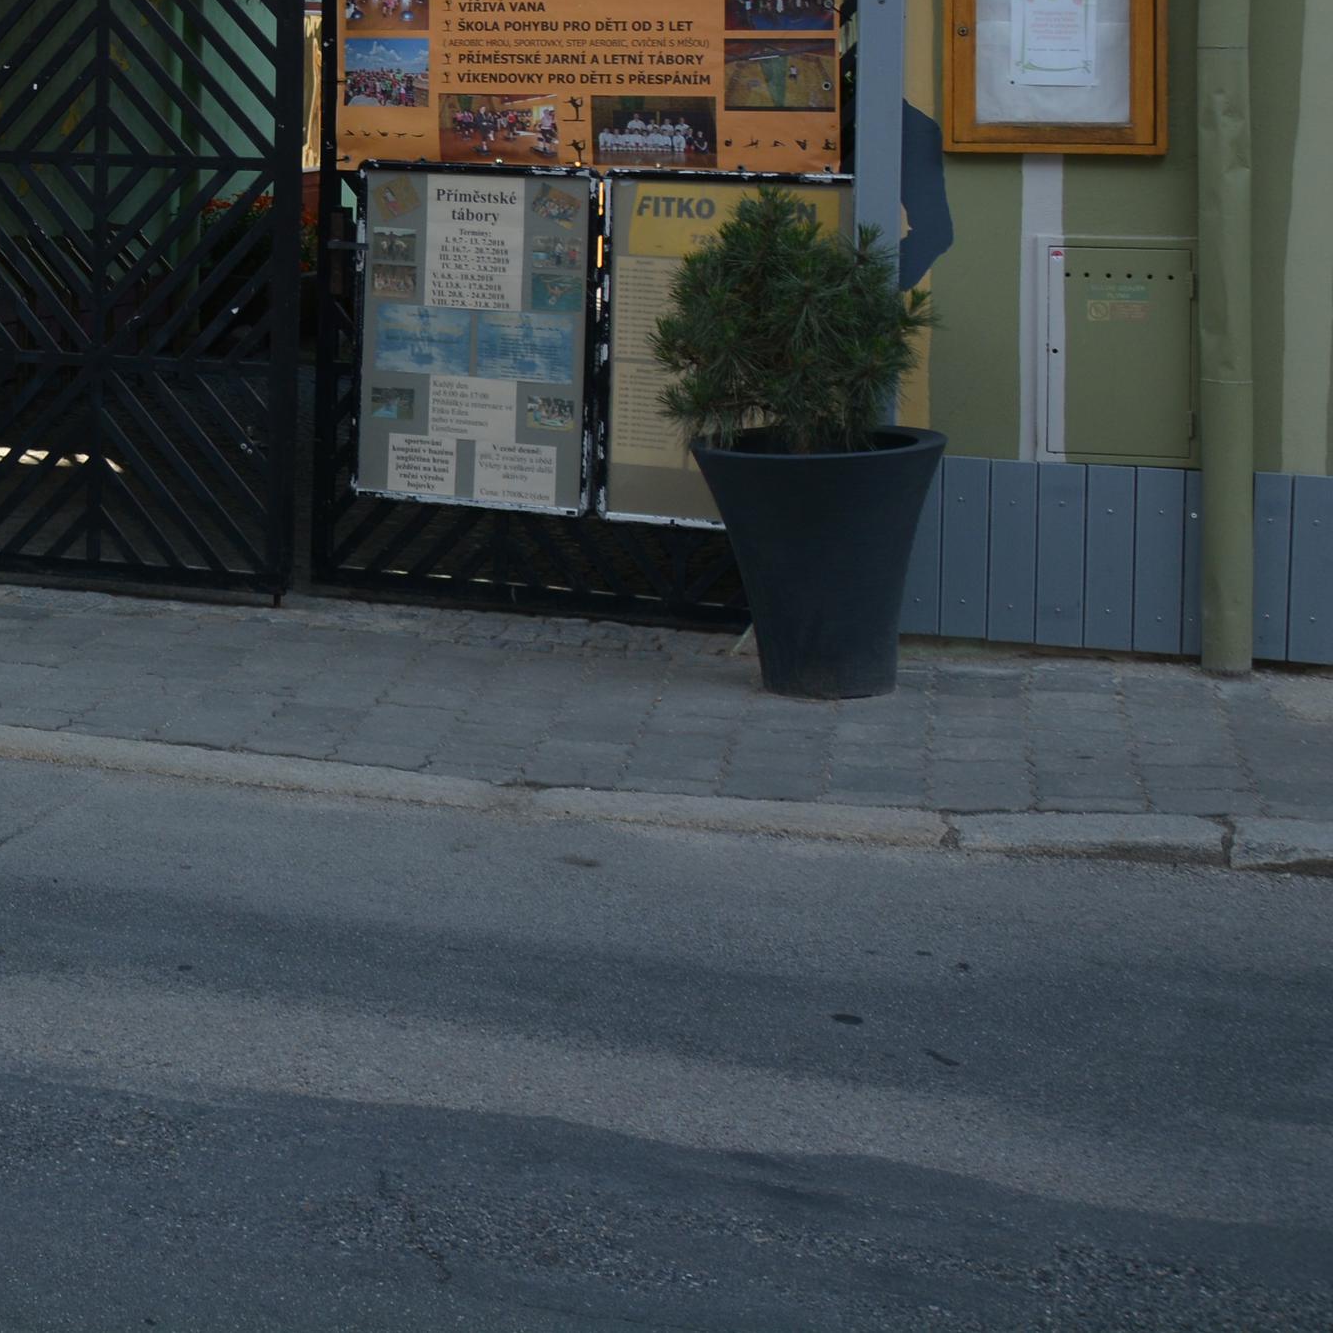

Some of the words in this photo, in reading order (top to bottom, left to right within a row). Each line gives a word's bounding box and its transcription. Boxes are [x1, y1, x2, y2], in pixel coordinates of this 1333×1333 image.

[509, 1, 545, 12] VANA
[458, 18, 500, 32] ŠKOLA
[504, 20, 559, 32] POHYBU
[563, 21, 591, 32] PRO
[595, 17, 628, 32] DĚTI
[631, 20, 652, 31] OD
[656, 21, 664, 31] 3
[669, 20, 693, 31] LET
[566, 39, 586, 47] STEP
[669, 39, 675, 47] S
[458, 50, 541, 65] PŘÍMĚSTSKÉ
[544, 51, 586, 65] JARNÍ
[591, 54, 599, 65] A
[603, 51, 644, 65] LETNÍ
[648, 51, 704, 65] TÁBORY
[457, 69, 544, 84] VÍKENDOVKY
[548, 73, 575, 84] PRO
[580, 70, 612, 84] DĚTI
[616, 74, 624, 84] S
[628, 71, 710, 85] PŘESPÁNÍM
[436, 188, 517, 205] Příměstské
[636, 195, 715, 219] FITKO
[451, 207, 499, 226] tábory
